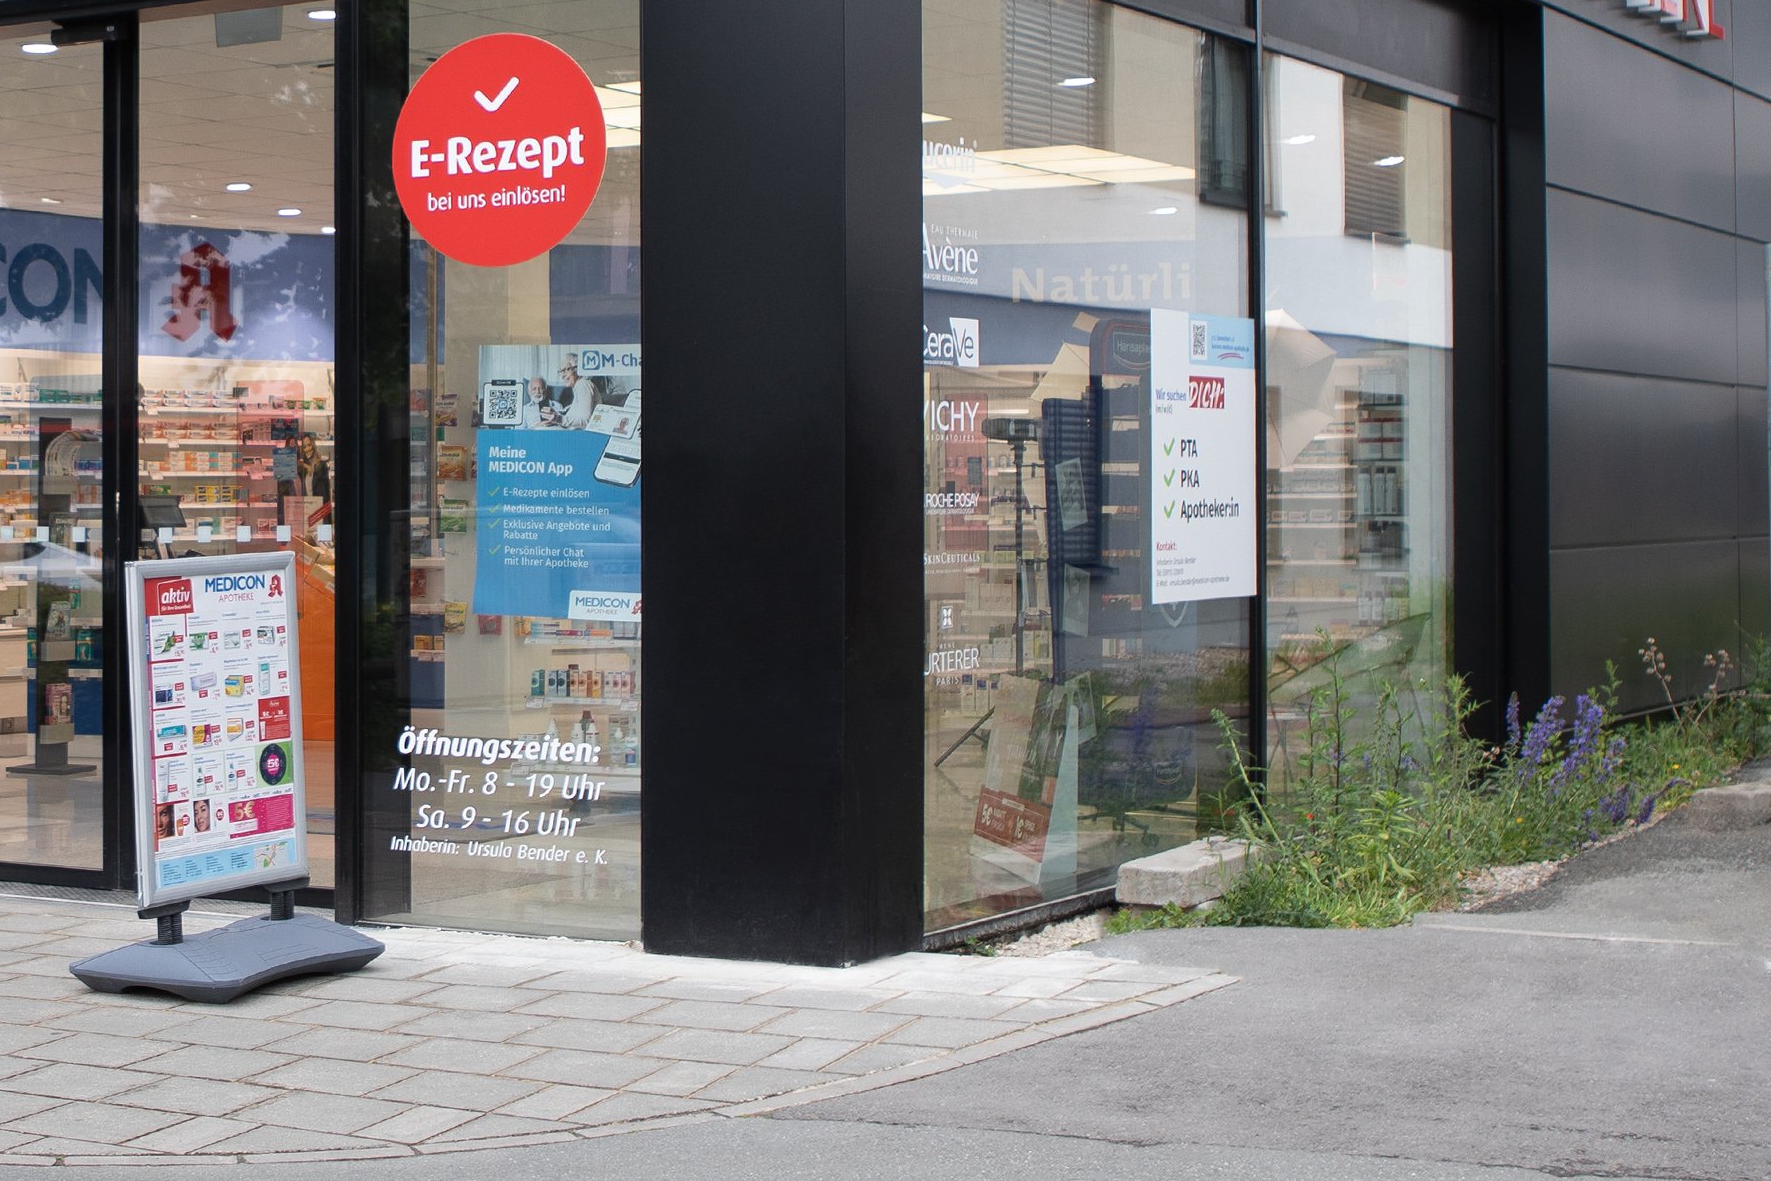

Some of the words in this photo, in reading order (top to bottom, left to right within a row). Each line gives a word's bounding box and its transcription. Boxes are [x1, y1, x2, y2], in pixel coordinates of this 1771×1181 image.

[411, 126, 585, 179] E-Rezept
[427, 193, 453, 212] bei
[458, 192, 487, 209] uns
[491, 184, 566, 207] einlösen!
[947, 226, 979, 239] THERMALE
[923, 222, 979, 275] Avène
[1155, 388, 1165, 400] Wir
[1166, 389, 1187, 401] suchen
[1189, 380, 1224, 409] DICH:
[489, 446, 526, 458] Meine
[1180, 439, 1198, 457] PTA
[489, 461, 545, 473] MEDICON
[548, 462, 573, 476] App
[1180, 469, 1200, 488] PKA
[503, 487, 548, 498] E-Rezepte
[550, 488, 590, 498] einlösen
[926, 493, 953, 507] ROCHE
[954, 493, 980, 507] POSAY
[503, 504, 564, 514] Medikamente
[566, 505, 609, 515] bestellen
[1180, 496, 1239, 523] Apotheker:in
[503, 520, 544, 530] Exklusive
[546, 521, 590, 532] Angebote
[592, 522, 611, 531] und
[503, 530, 538, 540] Rabatte
[504, 546, 560, 557] Persönlicher
[563, 547, 584, 558] Chat
[1156, 541, 1178, 551] Kontakt:
[504, 556, 519, 566] mit
[521, 557, 543, 566] Ihrer
[545, 558, 589, 569] Apotheke
[205, 574, 265, 593] MEDICON
[161, 586, 190, 604] aktiv
[218, 594, 254, 603] APOTHEKE
[575, 597, 630, 609] MEDICON
[586, 608, 618, 616] APOTHEKE
[936, 675, 960, 686] PARIS
[397, 725, 602, 765] Öffnungszeiten:
[392, 767, 475, 795] Mo.-Fr.
[481, 771, 498, 796] 8
[526, 773, 555, 798] 19
[561, 773, 606, 801] Uhr
[234, 801, 255, 821] 5€
[415, 804, 450, 829] Sa.
[460, 806, 477, 829] 9
[501, 809, 531, 834] 16
[537, 810, 581, 837] Uhr
[390, 835, 461, 855] Inhaberin:
[467, 841, 513, 859] Ursula
[517, 844, 570, 862] Bender
[575, 851, 589, 863] e.
[595, 849, 608, 865] K.
